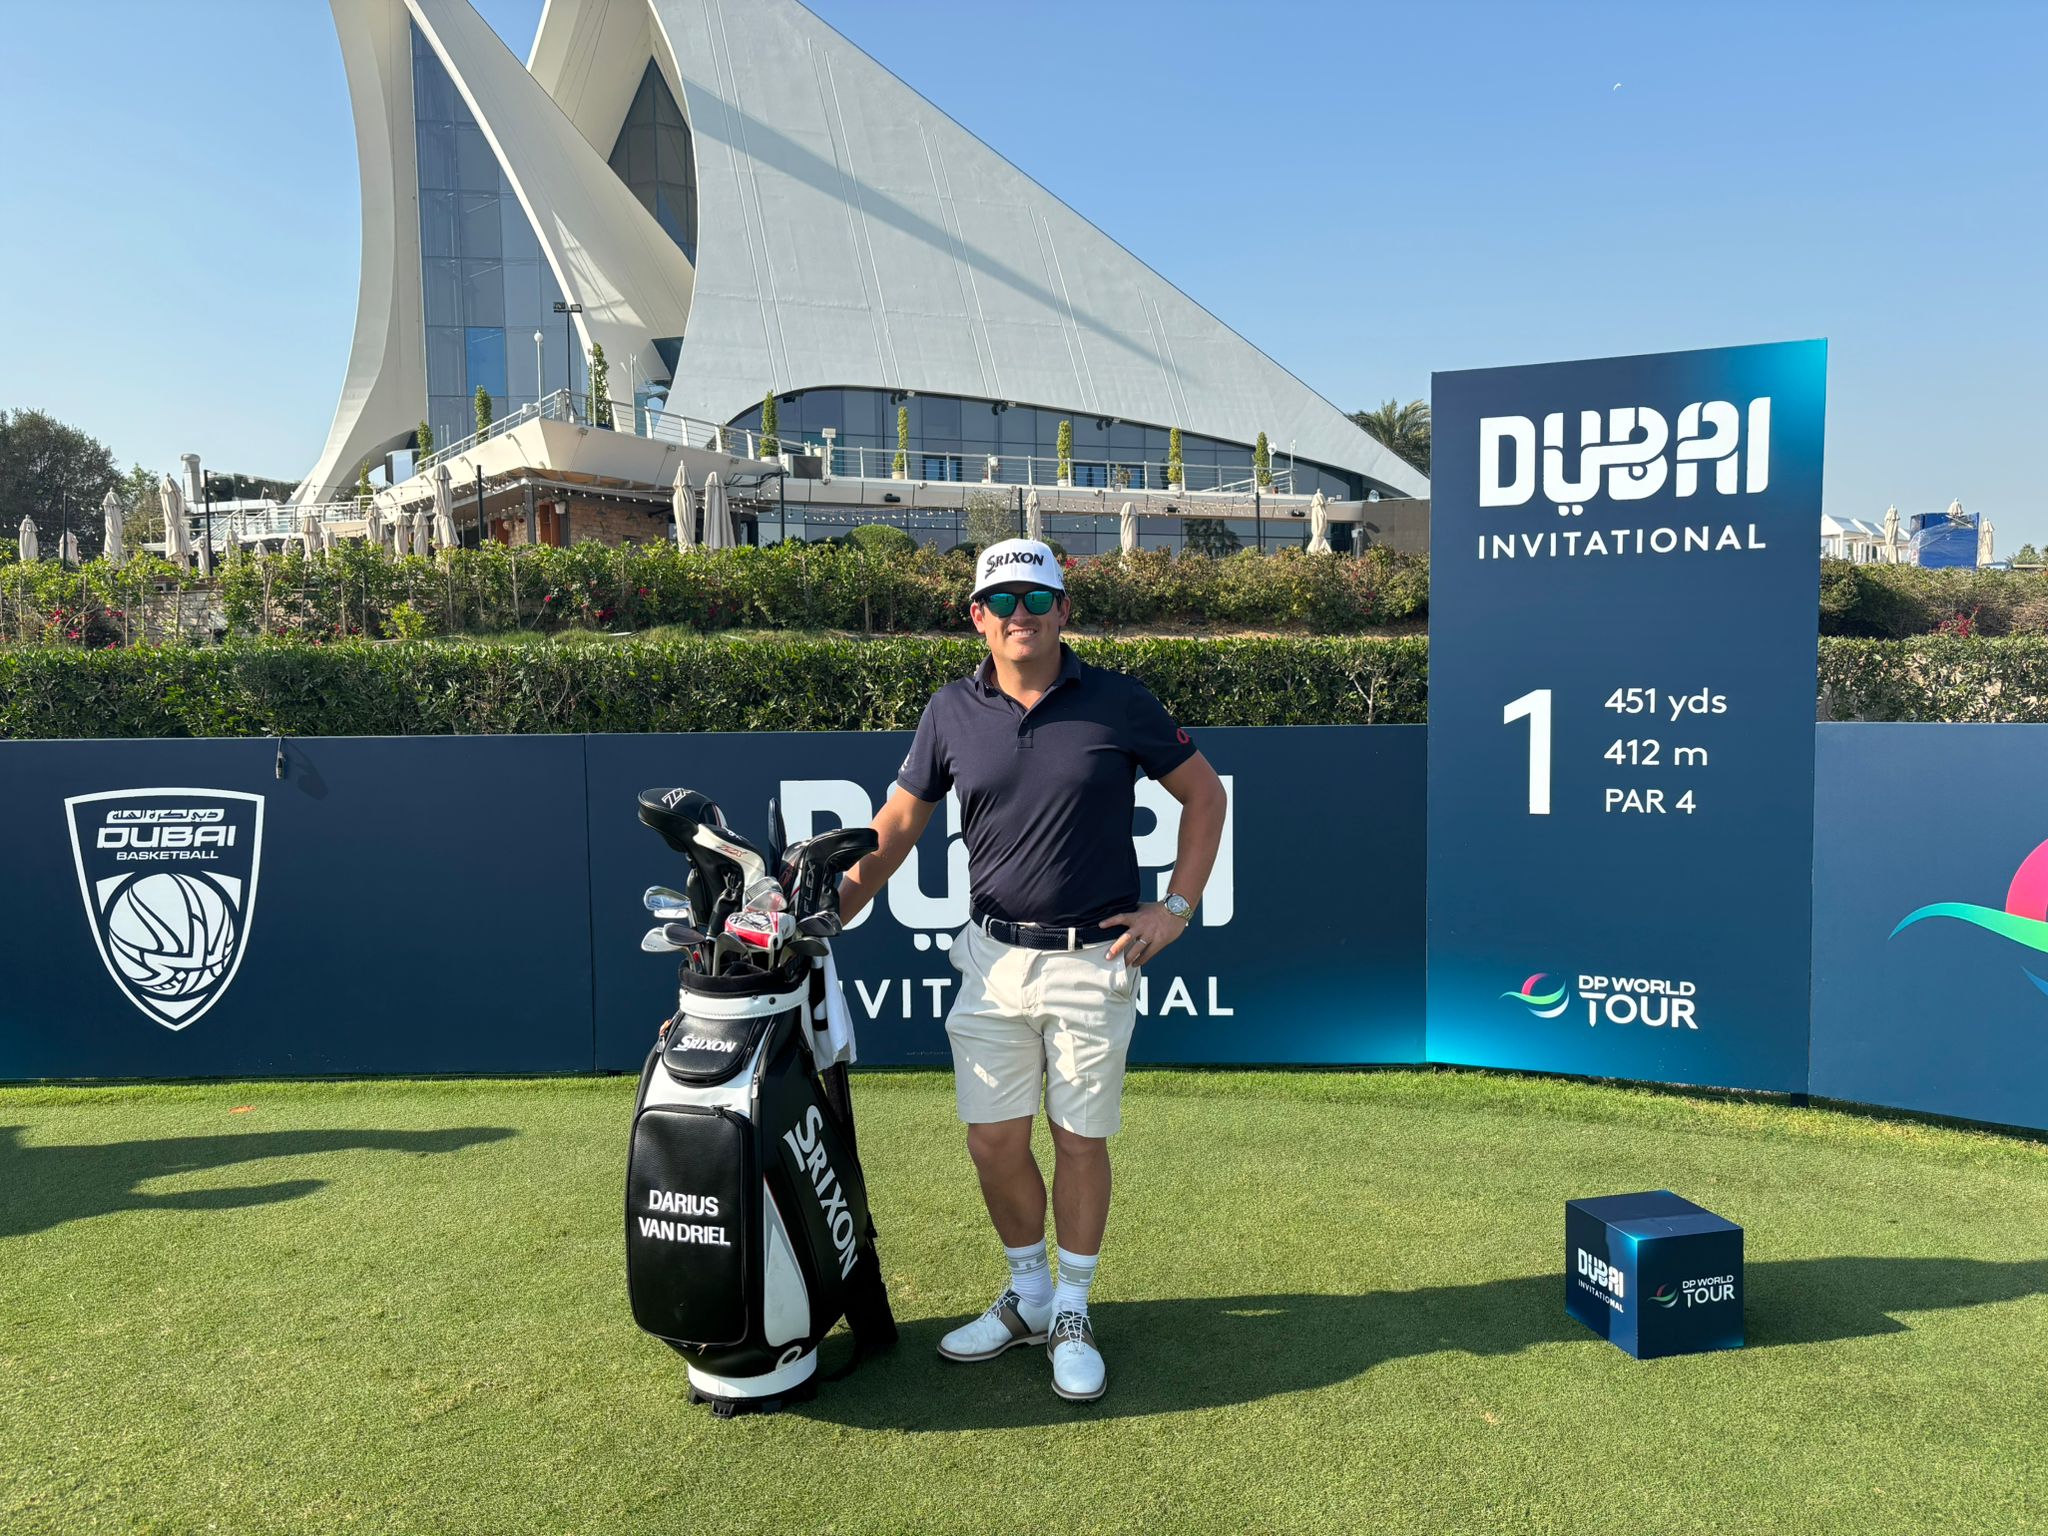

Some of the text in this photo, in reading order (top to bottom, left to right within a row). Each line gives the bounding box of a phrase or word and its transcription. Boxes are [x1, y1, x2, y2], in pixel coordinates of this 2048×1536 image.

[1479, 396, 1771, 517] DUBAI
[1478, 523, 1766, 560] INVITATIONAL
[984, 552, 1044, 579] SRIXON
[1604, 687, 1728, 722] 451 yds
[1503, 689, 1551, 815] 1
[1603, 739, 1708, 766] 412 m
[1605, 788, 1697, 815] PAR 4
[97, 825, 237, 849] DUBAI
[116, 850, 219, 861] BASKETBALL
[1579, 975, 1696, 997] DP WORLD
[1579, 991, 1699, 1030] TOUR
[672, 1033, 738, 1053] SRIXON
[648, 1189, 720, 1217] DARIUS
[782, 1104, 859, 1281] SRIXON
[638, 1216, 732, 1247] VAN DRIEL
[1577, 1248, 1624, 1299] DUBAI
[1682, 1275, 1734, 1289] DP WORLD
[1578, 1278, 1624, 1314] INVITATIONAL
[1682, 1284, 1735, 1309] TOUR
